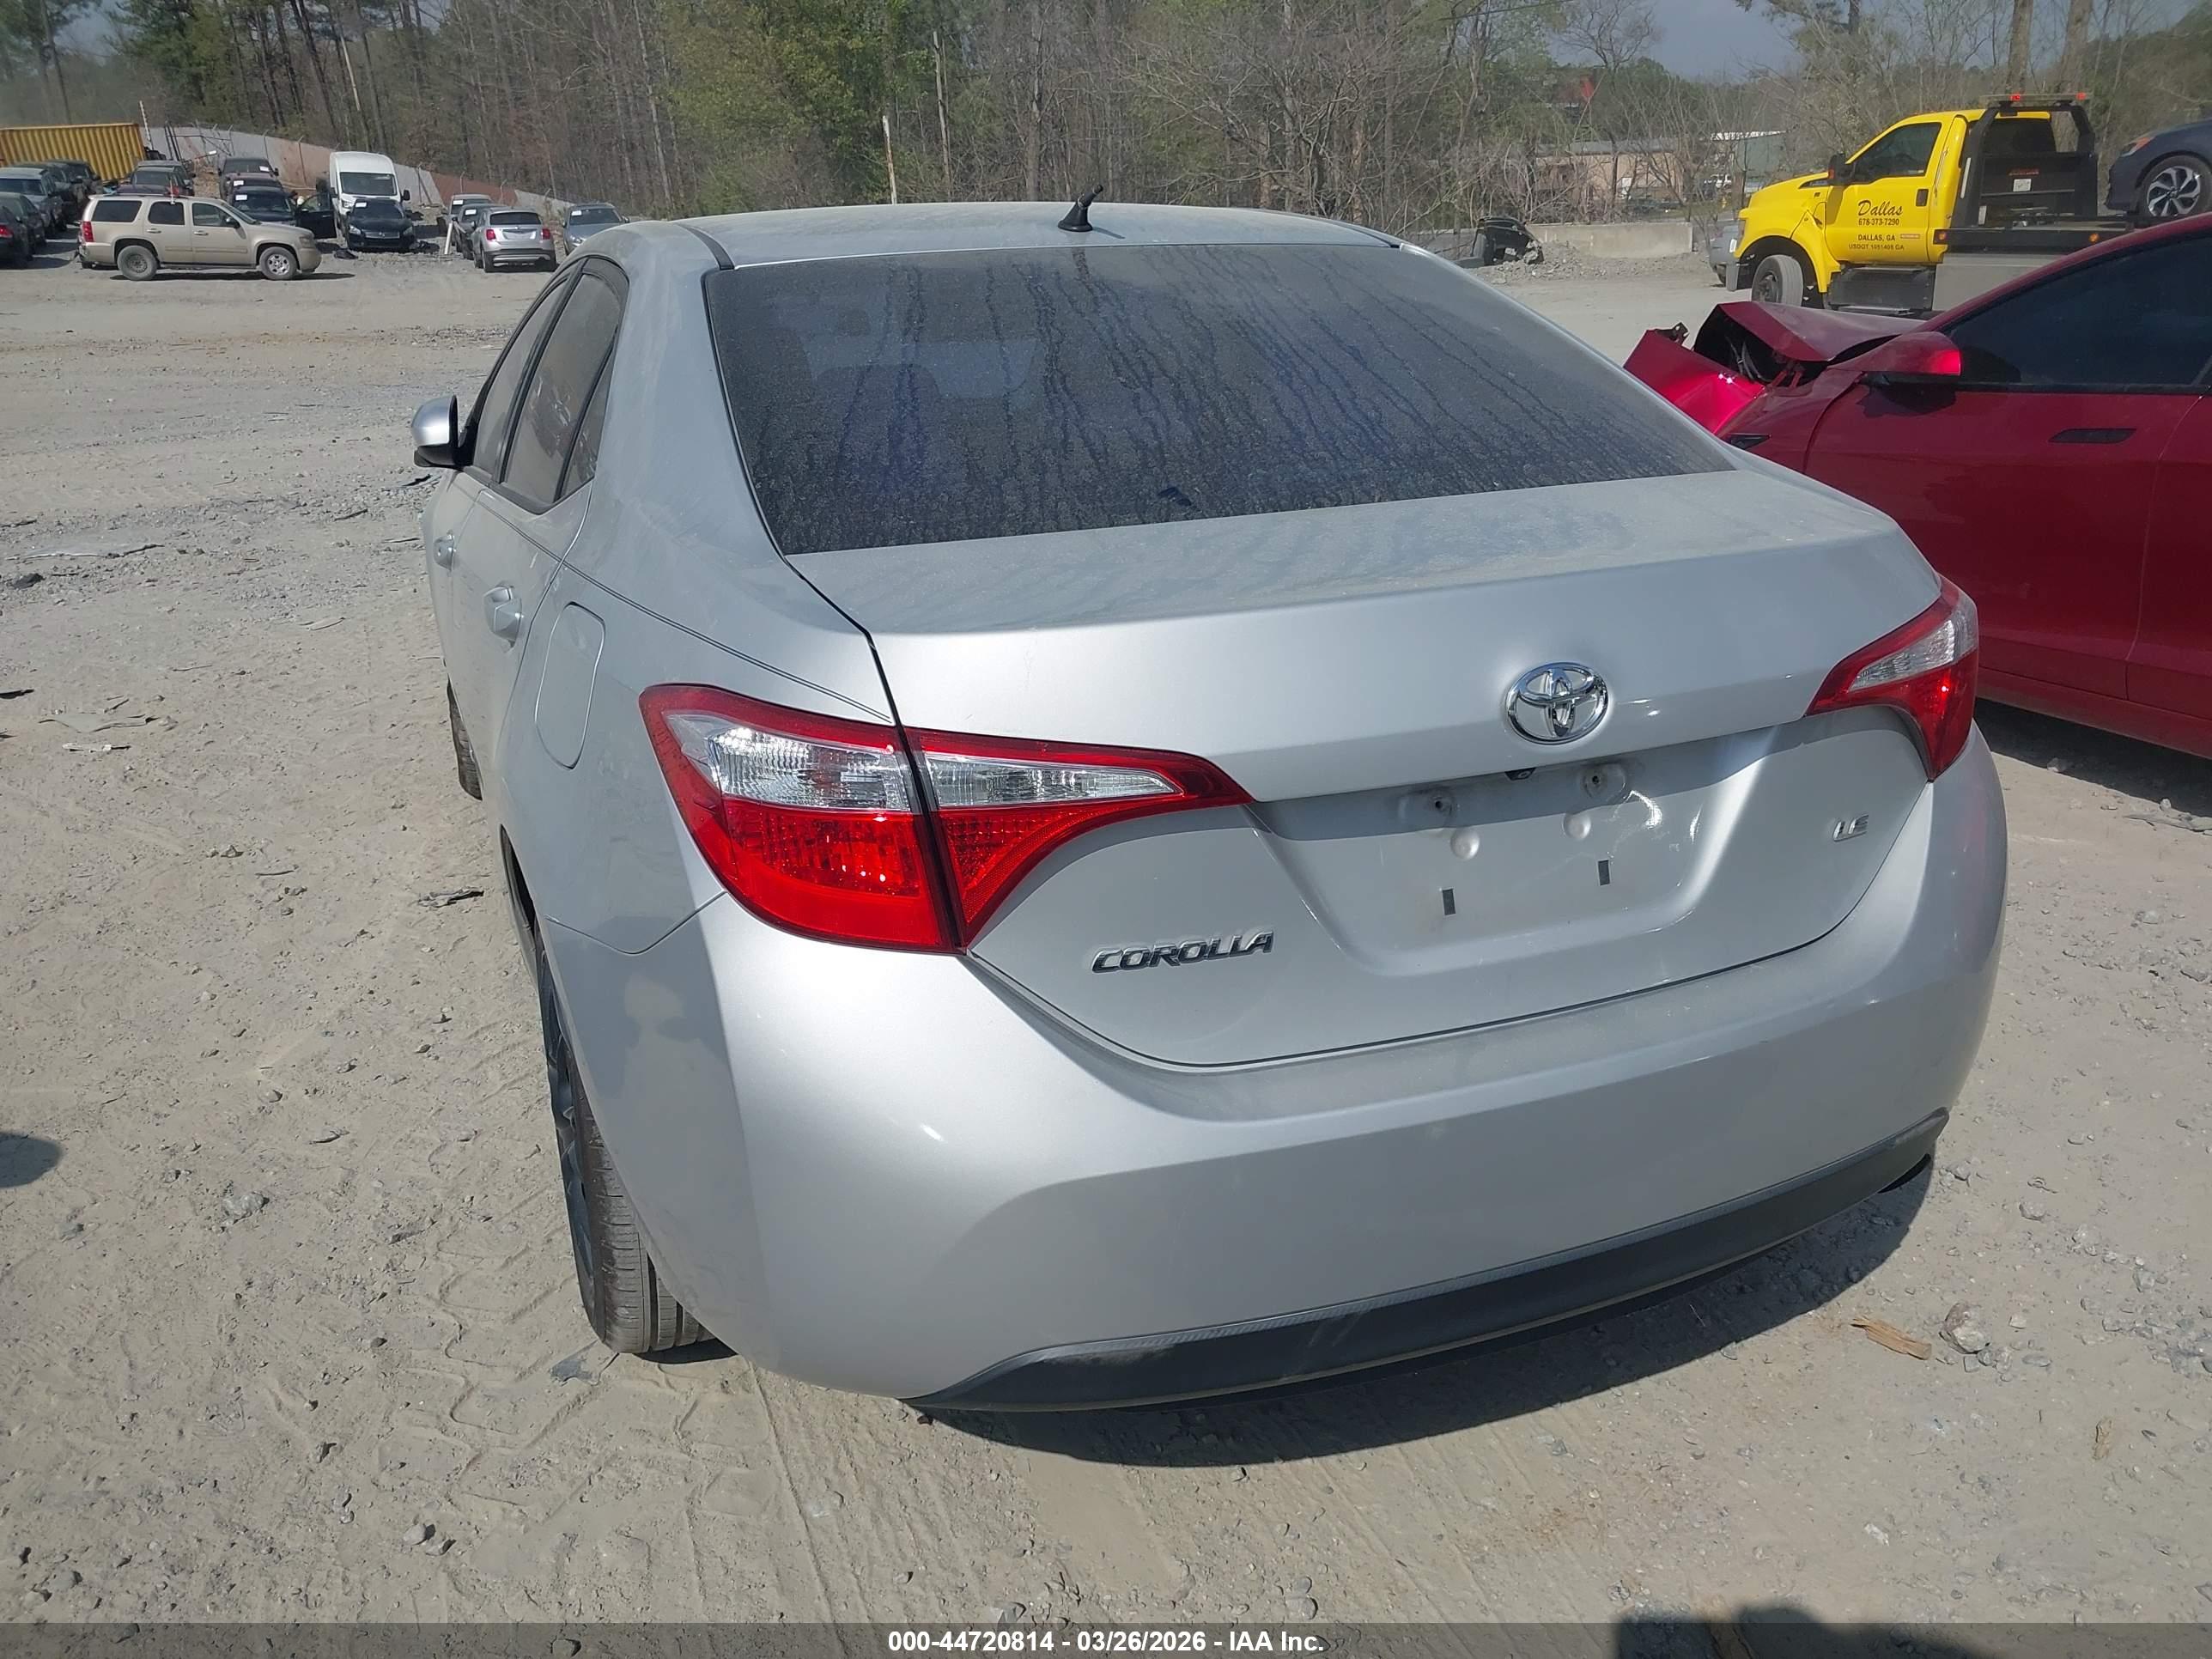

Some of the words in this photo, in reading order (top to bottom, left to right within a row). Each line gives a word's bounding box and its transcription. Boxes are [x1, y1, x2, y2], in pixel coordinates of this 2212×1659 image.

[1857, 199, 1904, 216] Dallas
[1832, 814, 1869, 842] LE
[1091, 930, 1274, 974] COROLLA
